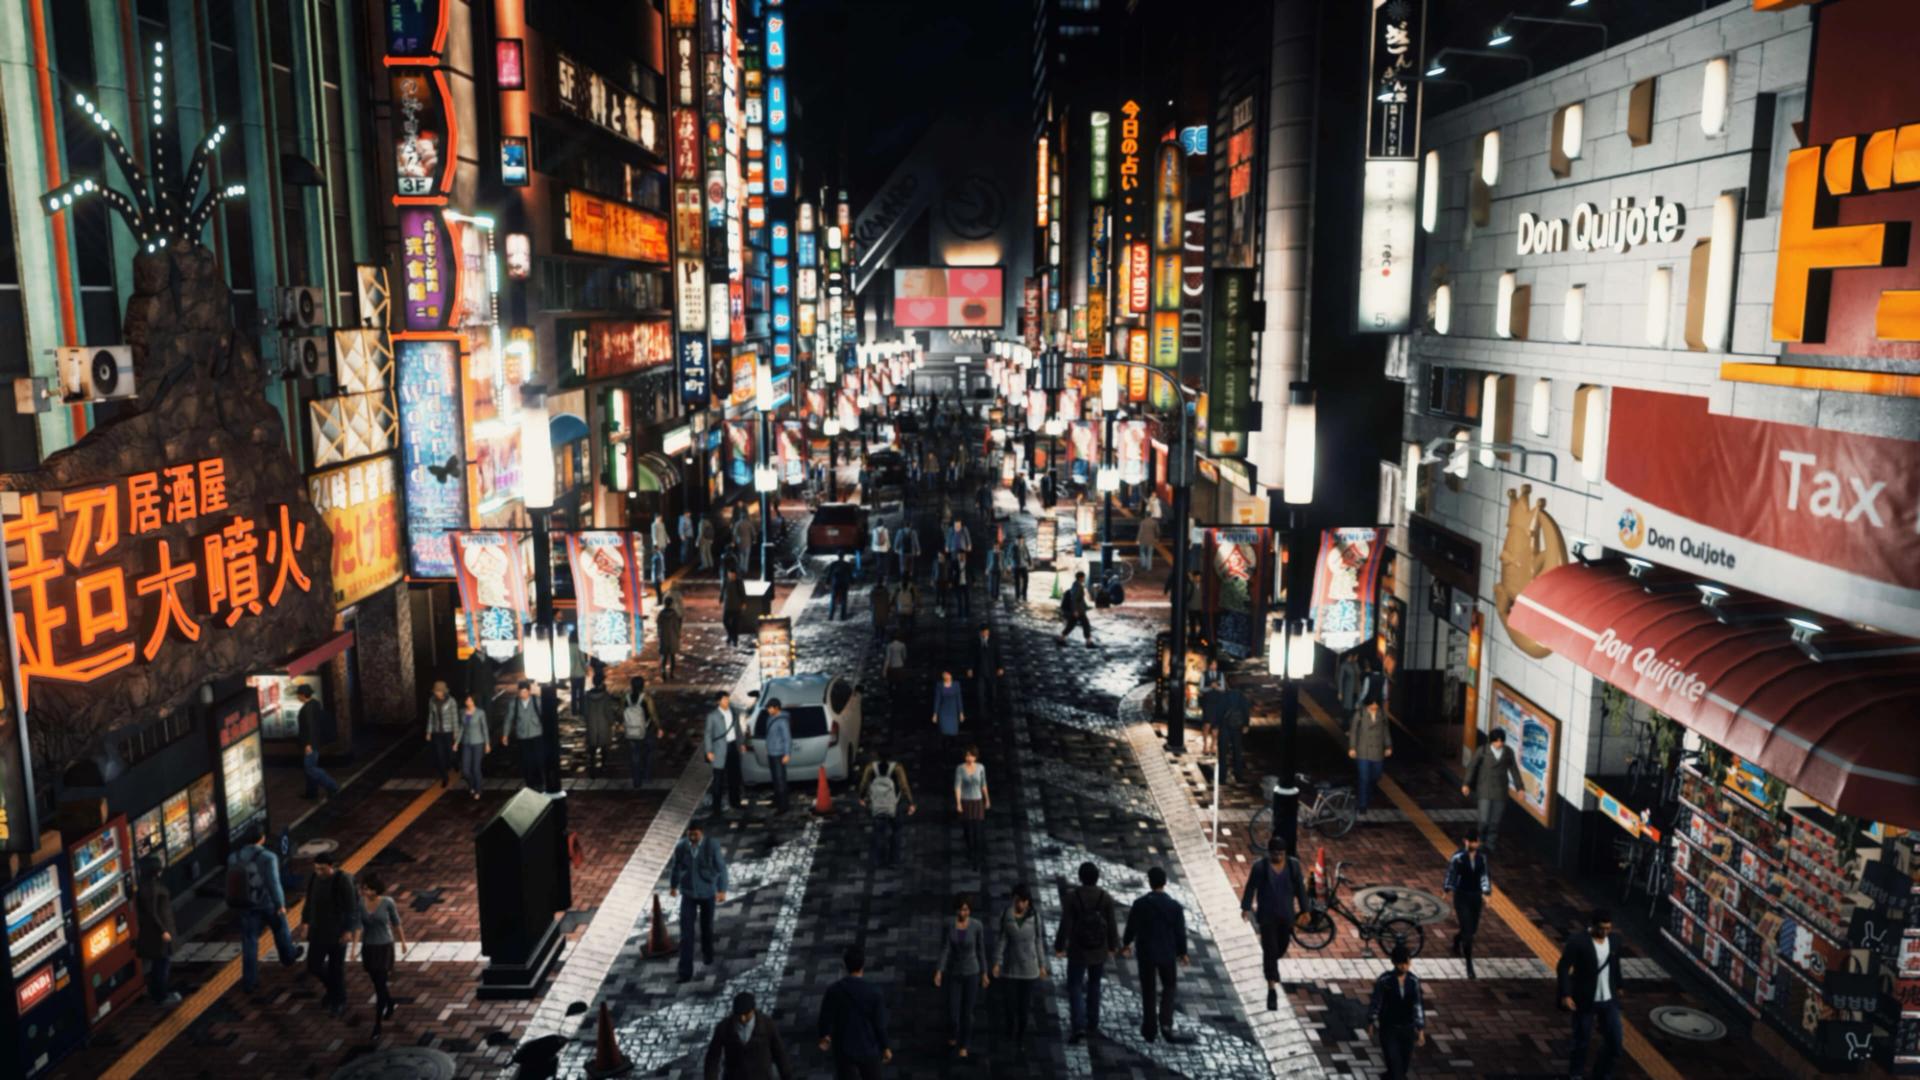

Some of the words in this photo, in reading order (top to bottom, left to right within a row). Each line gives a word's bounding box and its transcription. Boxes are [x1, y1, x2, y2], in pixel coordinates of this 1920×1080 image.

[403, 179, 426, 193] 3F
[1517, 211, 1566, 256] Don
[1571, 196, 1684, 254] Quijote
[127, 457, 229, 535] 居酒屋
[1779, 449, 1887, 528] Tax
[1648, 528, 1676, 552] Don
[1680, 537, 1736, 570] Quijote
[1594, 627, 1633, 665] Don
[1632, 640, 1707, 702] Quijote
